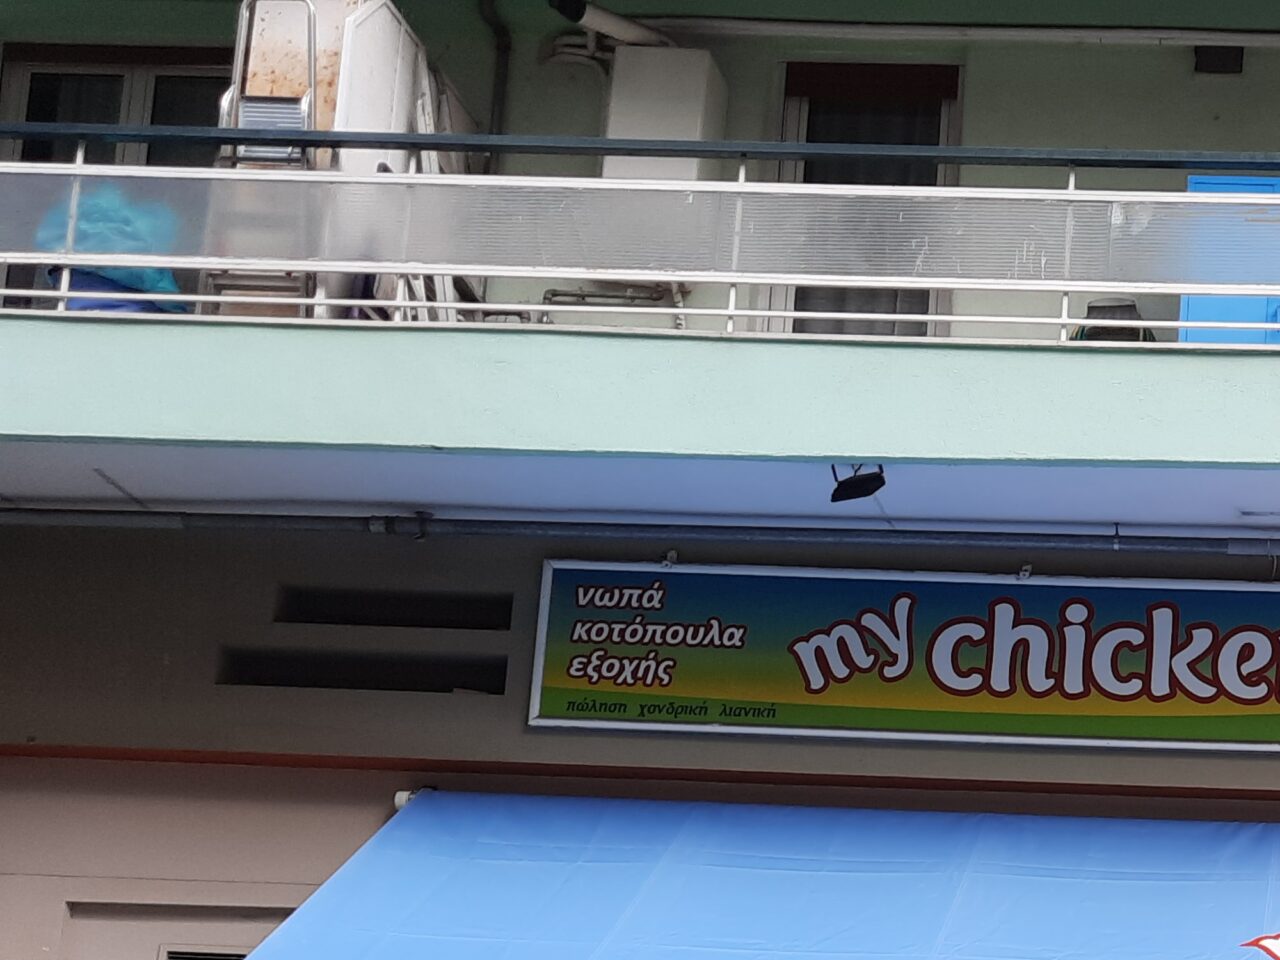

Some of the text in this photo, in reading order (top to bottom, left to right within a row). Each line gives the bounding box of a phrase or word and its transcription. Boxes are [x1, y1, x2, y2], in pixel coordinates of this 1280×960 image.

[576, 581, 664, 611] νωπά
[570, 618, 747, 649] κοτόπουλα
[787, 592, 917, 694] my
[566, 651, 675, 687] εξοχής
[566, 698, 777, 718] πώληση χονδρική λιανική
